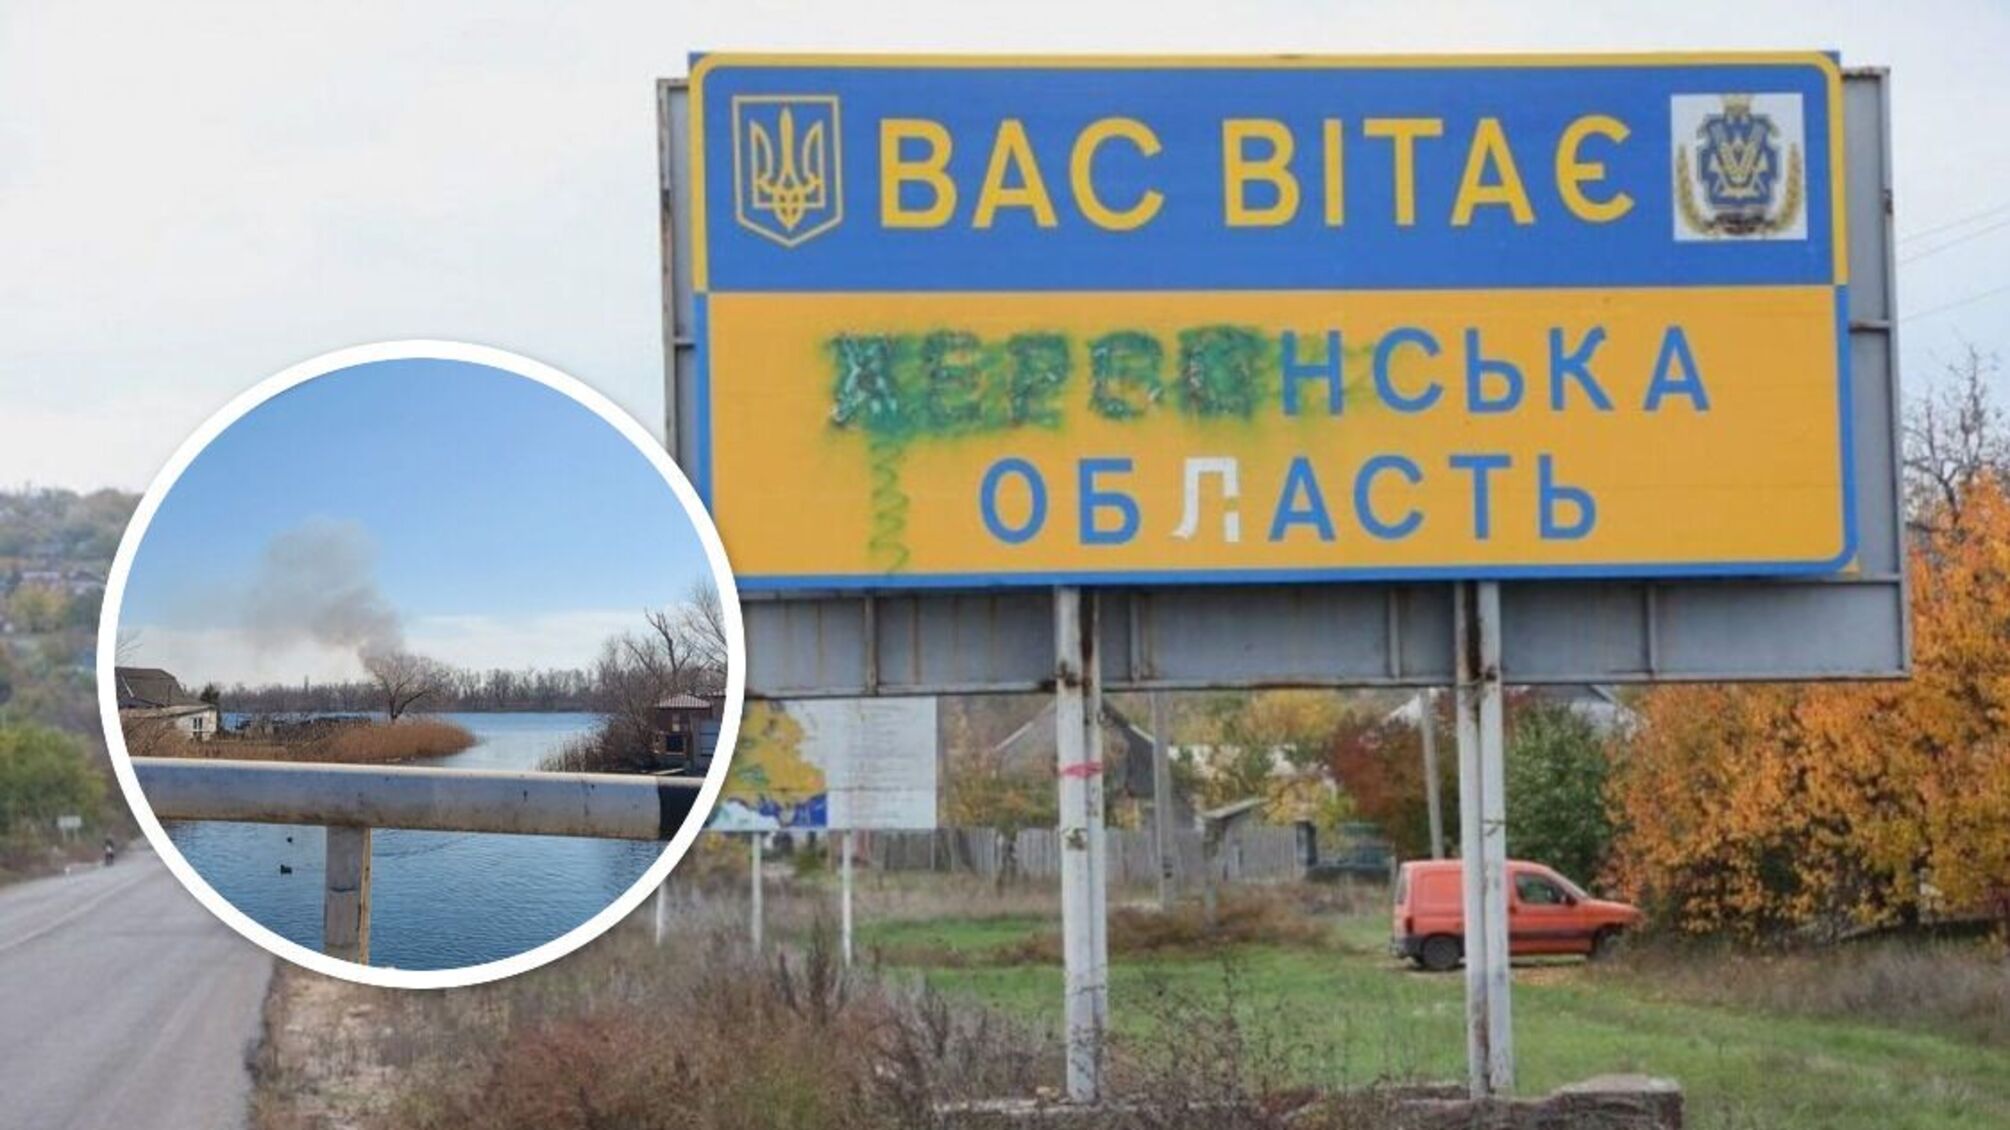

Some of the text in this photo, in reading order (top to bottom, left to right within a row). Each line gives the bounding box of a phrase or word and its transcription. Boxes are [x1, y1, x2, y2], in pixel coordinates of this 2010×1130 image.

[878, 115, 1635, 231] ВАС ВІТАЄ
[978, 455, 1598, 546] ОБЛАСТЬ
